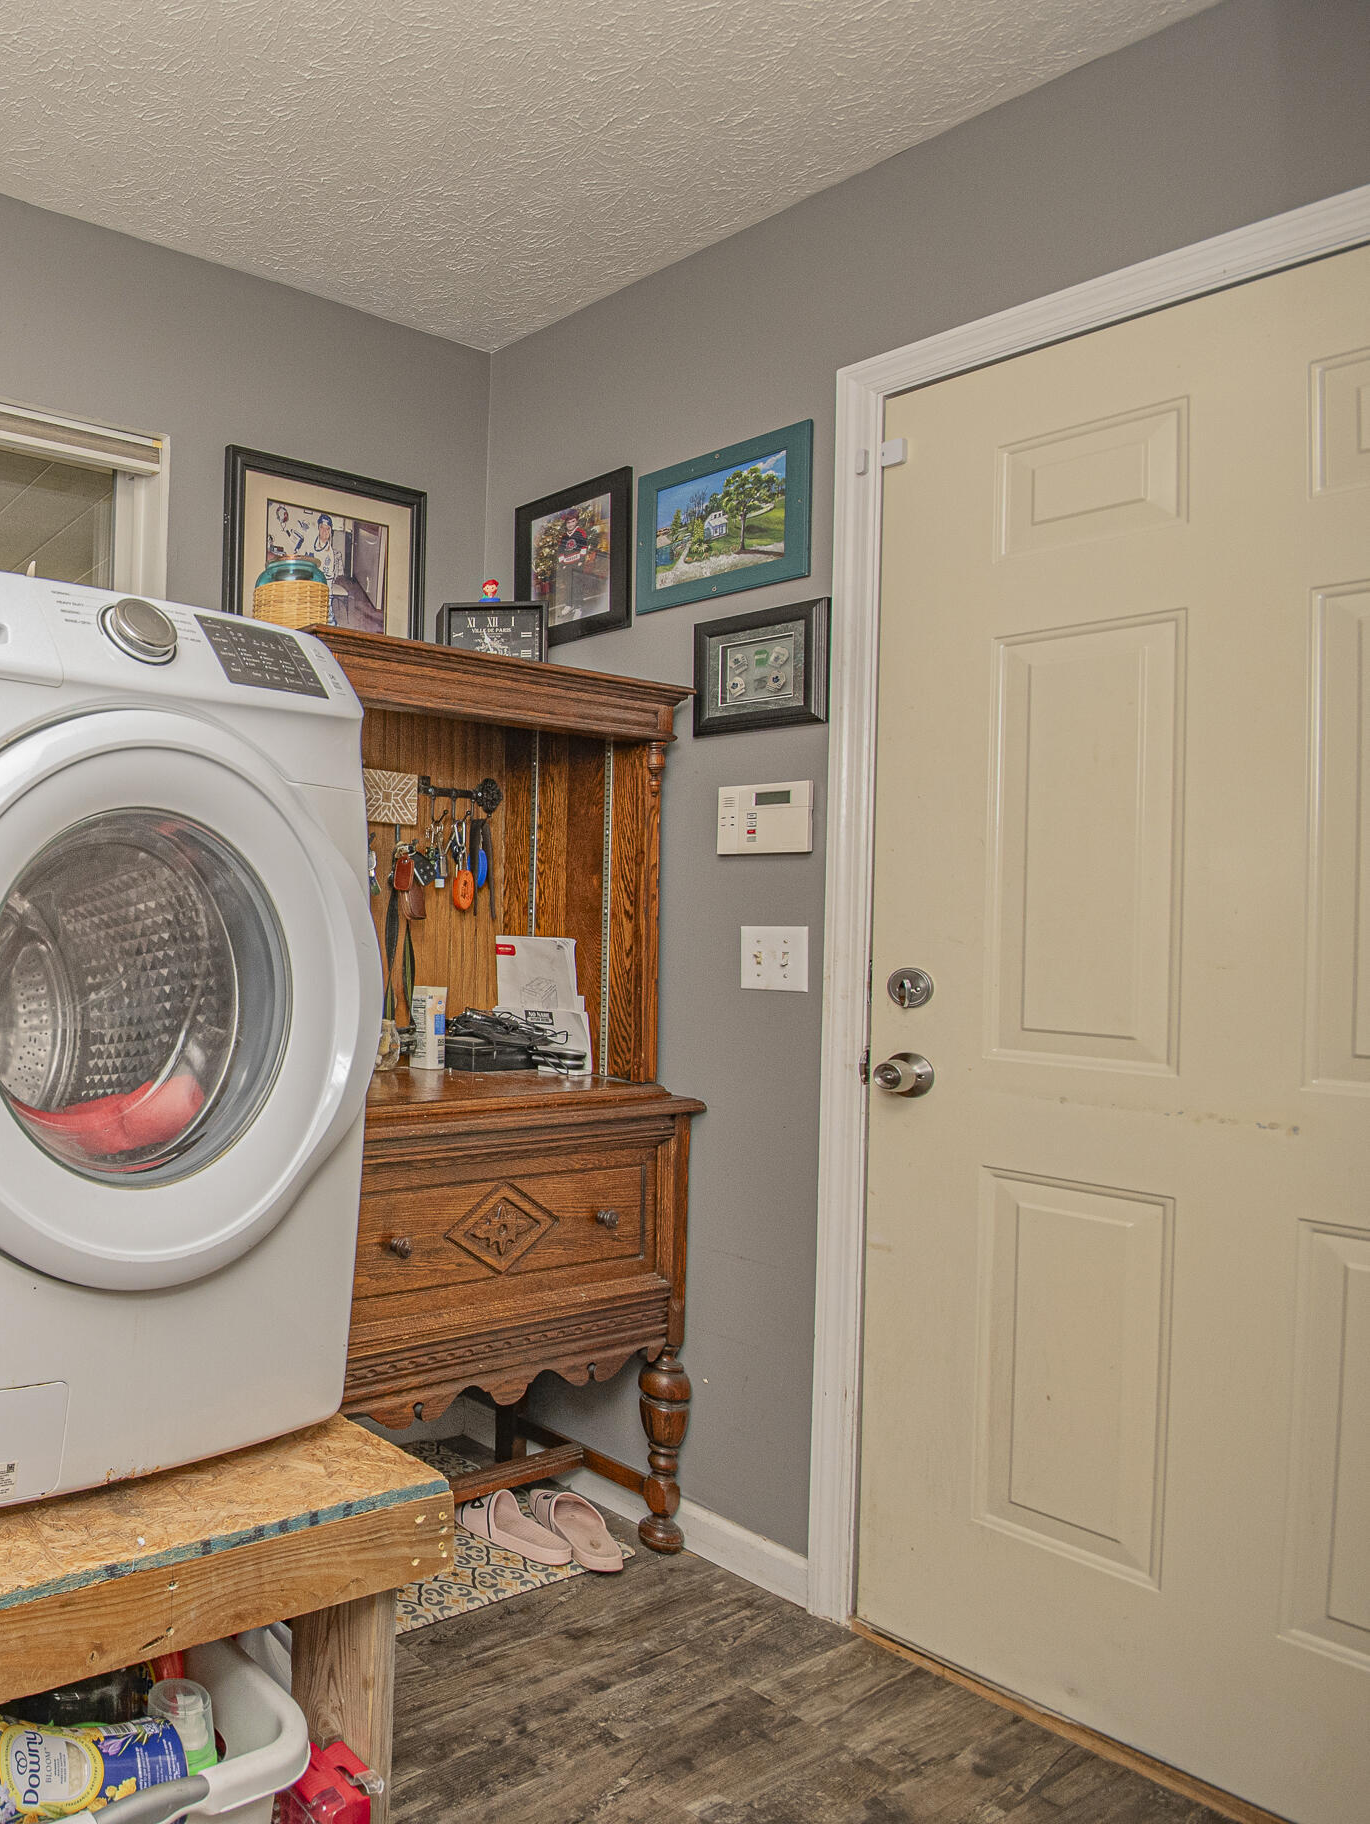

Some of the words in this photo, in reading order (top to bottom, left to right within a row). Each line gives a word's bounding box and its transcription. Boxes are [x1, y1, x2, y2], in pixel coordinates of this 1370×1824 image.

[467, 616, 476, 628] XI
[487, 616, 498, 628] XII
[22, 1730, 44, 1805] Downy
